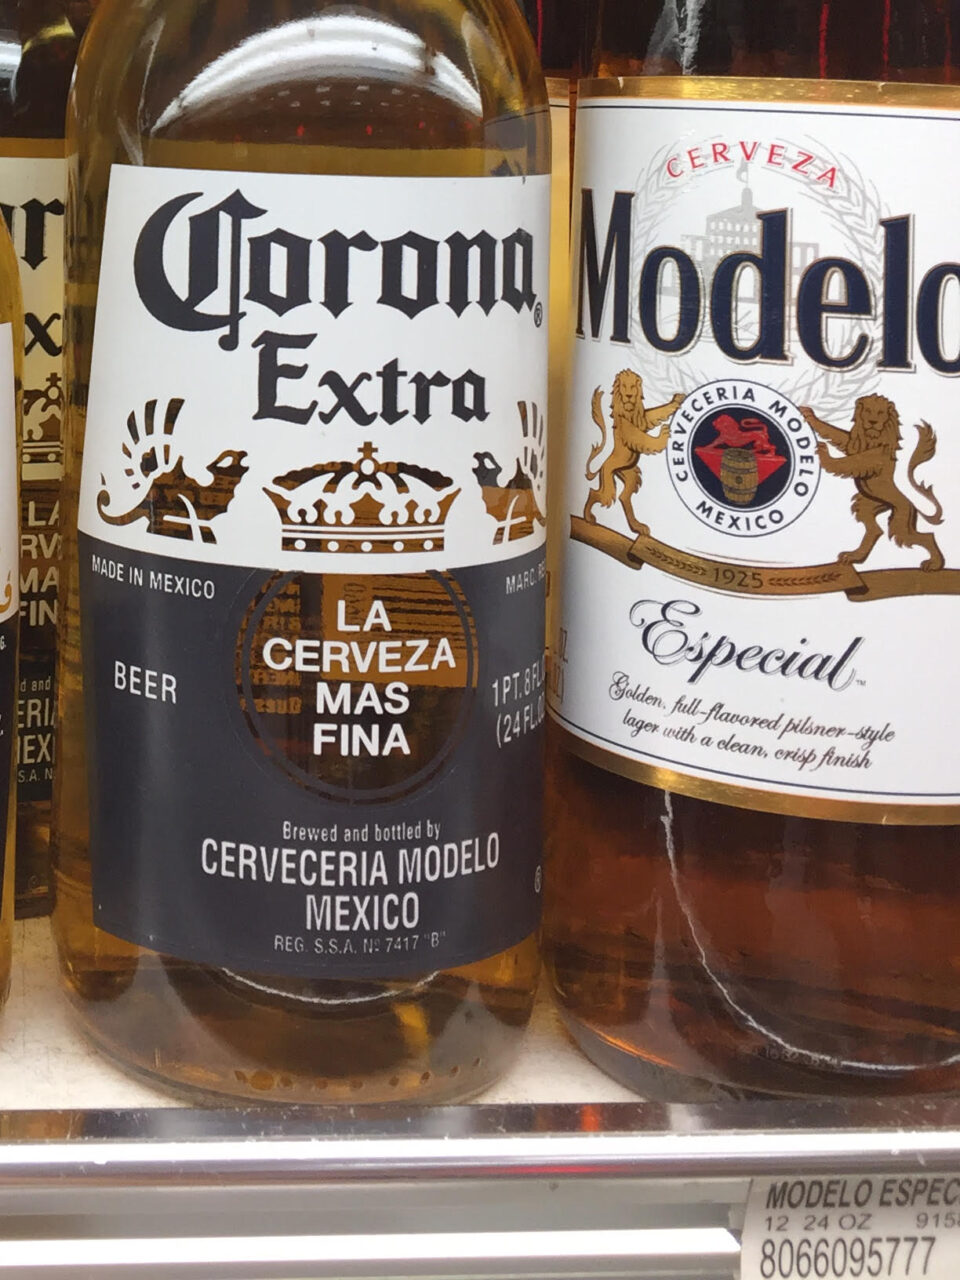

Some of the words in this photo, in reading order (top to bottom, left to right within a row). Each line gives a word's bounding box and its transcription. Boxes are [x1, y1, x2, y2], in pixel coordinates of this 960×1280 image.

[665, 140, 841, 189] CERVEZA
[133, 188, 538, 352] Corona
[576, 186, 960, 378] Modelo
[253, 329, 491, 428] Extra
[673, 386, 756, 482] CERVECERIA
[768, 400, 814, 497] MODELO
[696, 500, 784, 531] MEXICO
[20, 566, 60, 593] MA
[92, 554, 125, 582] MADE
[129, 566, 143, 587] IN
[150, 571, 215, 600] MEXICO
[713, 569, 764, 589] 1925
[337, 599, 392, 632] LA
[262, 637, 456, 673] CERVEZA
[629, 599, 866, 691] Especial
[31, 677, 52, 693] and
[114, 660, 177, 704] BEER
[315, 681, 410, 715] MAS
[313, 723, 411, 757] FINA
[623, 709, 660, 737] lager
[663, 725, 697, 744] with
[701, 734, 714, 747] a
[716, 734, 769, 758] clean,
[774, 747, 817, 771] crisp
[810, 746, 872, 771] finish
[670, 696, 782, 730] full-flavored
[779, 713, 896, 750] pilsner-style
[282, 820, 337, 842] Brewed
[344, 824, 368, 842] and
[375, 822, 421, 842] bottled
[426, 819, 441, 840] by
[201, 838, 389, 887] CERVECERIA
[398, 832, 500, 885] MODELO
[305, 892, 420, 932] MEXICO
[274, 934, 306, 953] REG.
[314, 937, 358, 954] S.S.A.
[386, 934, 420, 952] 7417
[766, 1179, 873, 1209] MODELO
[879, 1177, 960, 1208] ESPEC
[765, 1215, 790, 1232] 12
[803, 1215, 830, 1231] 24
[838, 1212, 873, 1231] OZ
[760, 1236, 936, 1279] 8066095777
